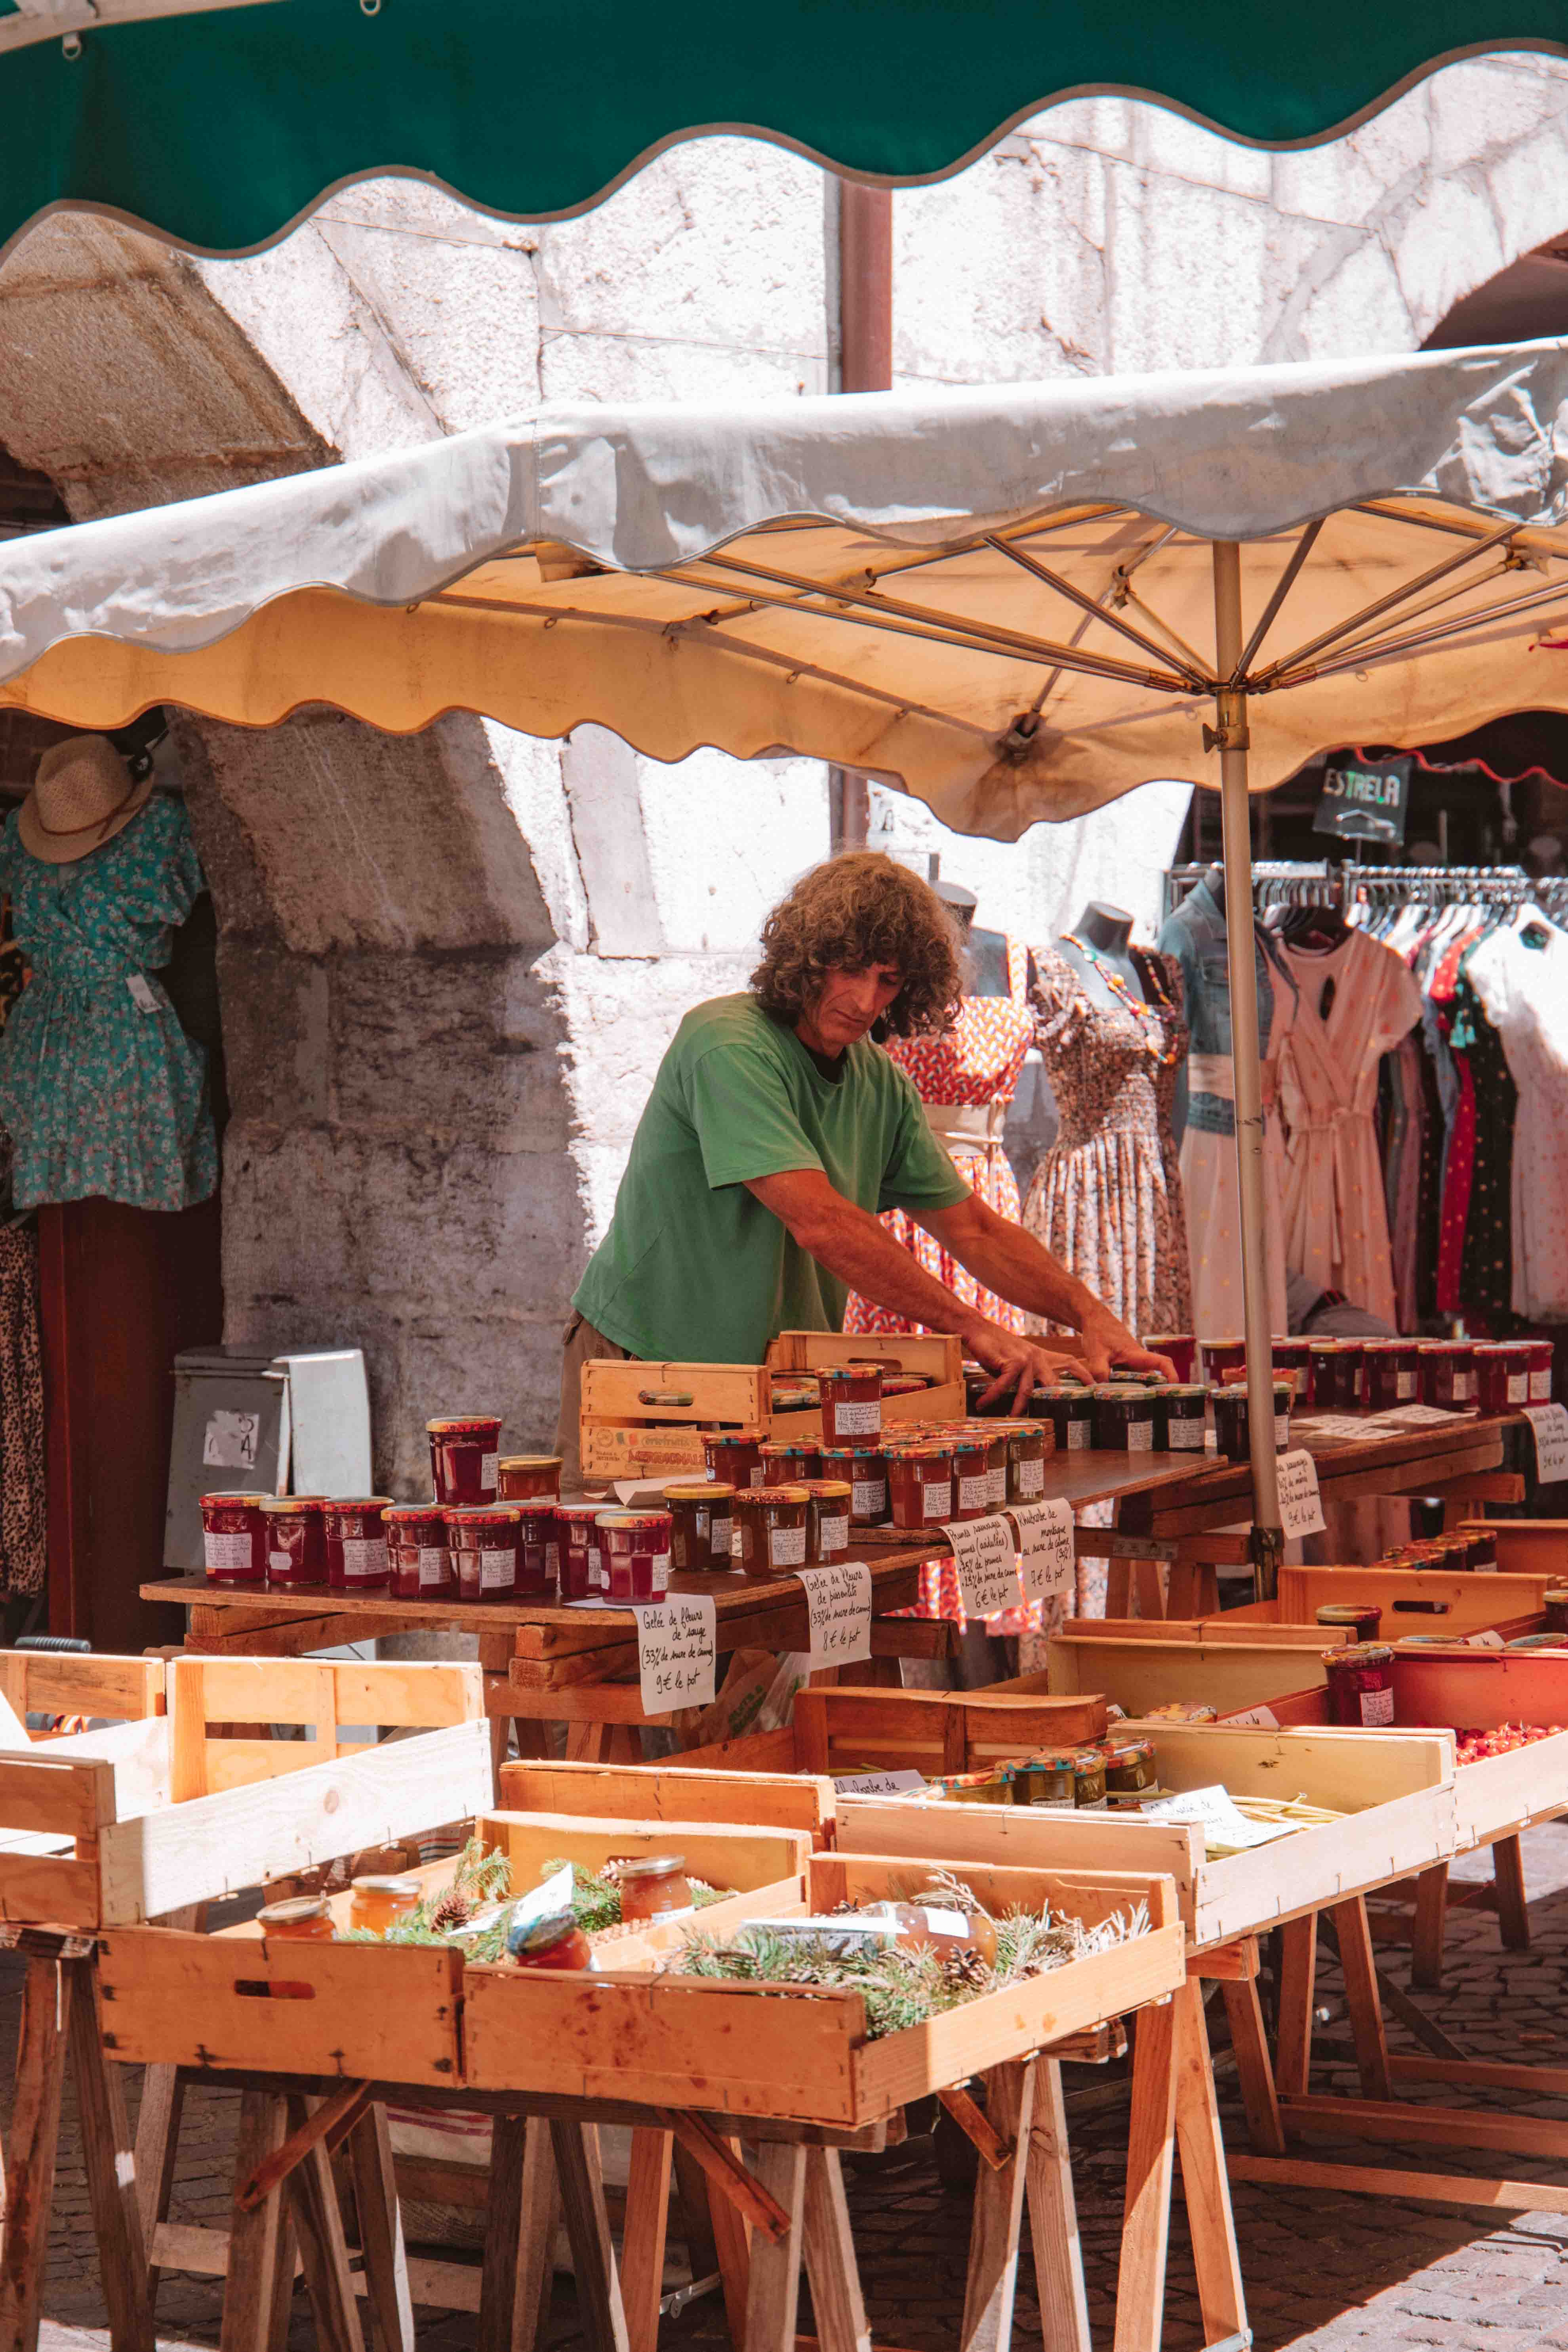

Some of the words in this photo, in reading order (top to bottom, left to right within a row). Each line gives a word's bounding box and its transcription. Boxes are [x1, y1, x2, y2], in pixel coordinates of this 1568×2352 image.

[1017, 1508, 1047, 1527] Rhubarbe
[1047, 1505, 1058, 1520] de
[947, 1529, 971, 1543] Prunes
[973, 1520, 1002, 1535] sauvages
[1040, 1523, 1066, 1541] montagne
[956, 1543, 976, 1563] jaunes
[1023, 1548, 1030, 1556] au
[1032, 1544, 1046, 1555] sucre
[1048, 1538, 1054, 1551] de
[1054, 1537, 1070, 1548] canne
[1056, 1545, 1071, 1564] (30%)
[975, 1557, 983, 1570] de
[984, 1554, 1002, 1572] prunes
[806, 1573, 829, 1591] Gelée
[830, 1571, 840, 1584] de
[839, 1567, 863, 1588] fleurs
[977, 1572, 983, 1585] de
[984, 1572, 996, 1583] sucre
[997, 1567, 1004, 1578] de
[1046, 1565, 1052, 1584] le
[1054, 1563, 1065, 1588] pot
[817, 1589, 827, 1605] de
[829, 1584, 857, 1608] pissenlits
[990, 1587, 996, 1601] le
[998, 1583, 1009, 1606] pot
[643, 1610, 665, 1630] Gelée
[669, 1610, 677, 1626] de
[681, 1607, 703, 1629] fleurs
[825, 1607, 831, 1621] de
[833, 1607, 847, 1619] sucre
[848, 1601, 856, 1615] de
[672, 1626, 682, 1642] de
[686, 1627, 707, 1644] sauge
[840, 1626, 846, 1645] le
[848, 1626, 861, 1650] pot
[661, 1646, 668, 1661] de
[670, 1649, 686, 1661] sucre
[688, 1644, 695, 1659] de
[674, 1670, 684, 1689] le
[687, 1666, 701, 1693] pot
[885, 1777, 900, 1790] de
